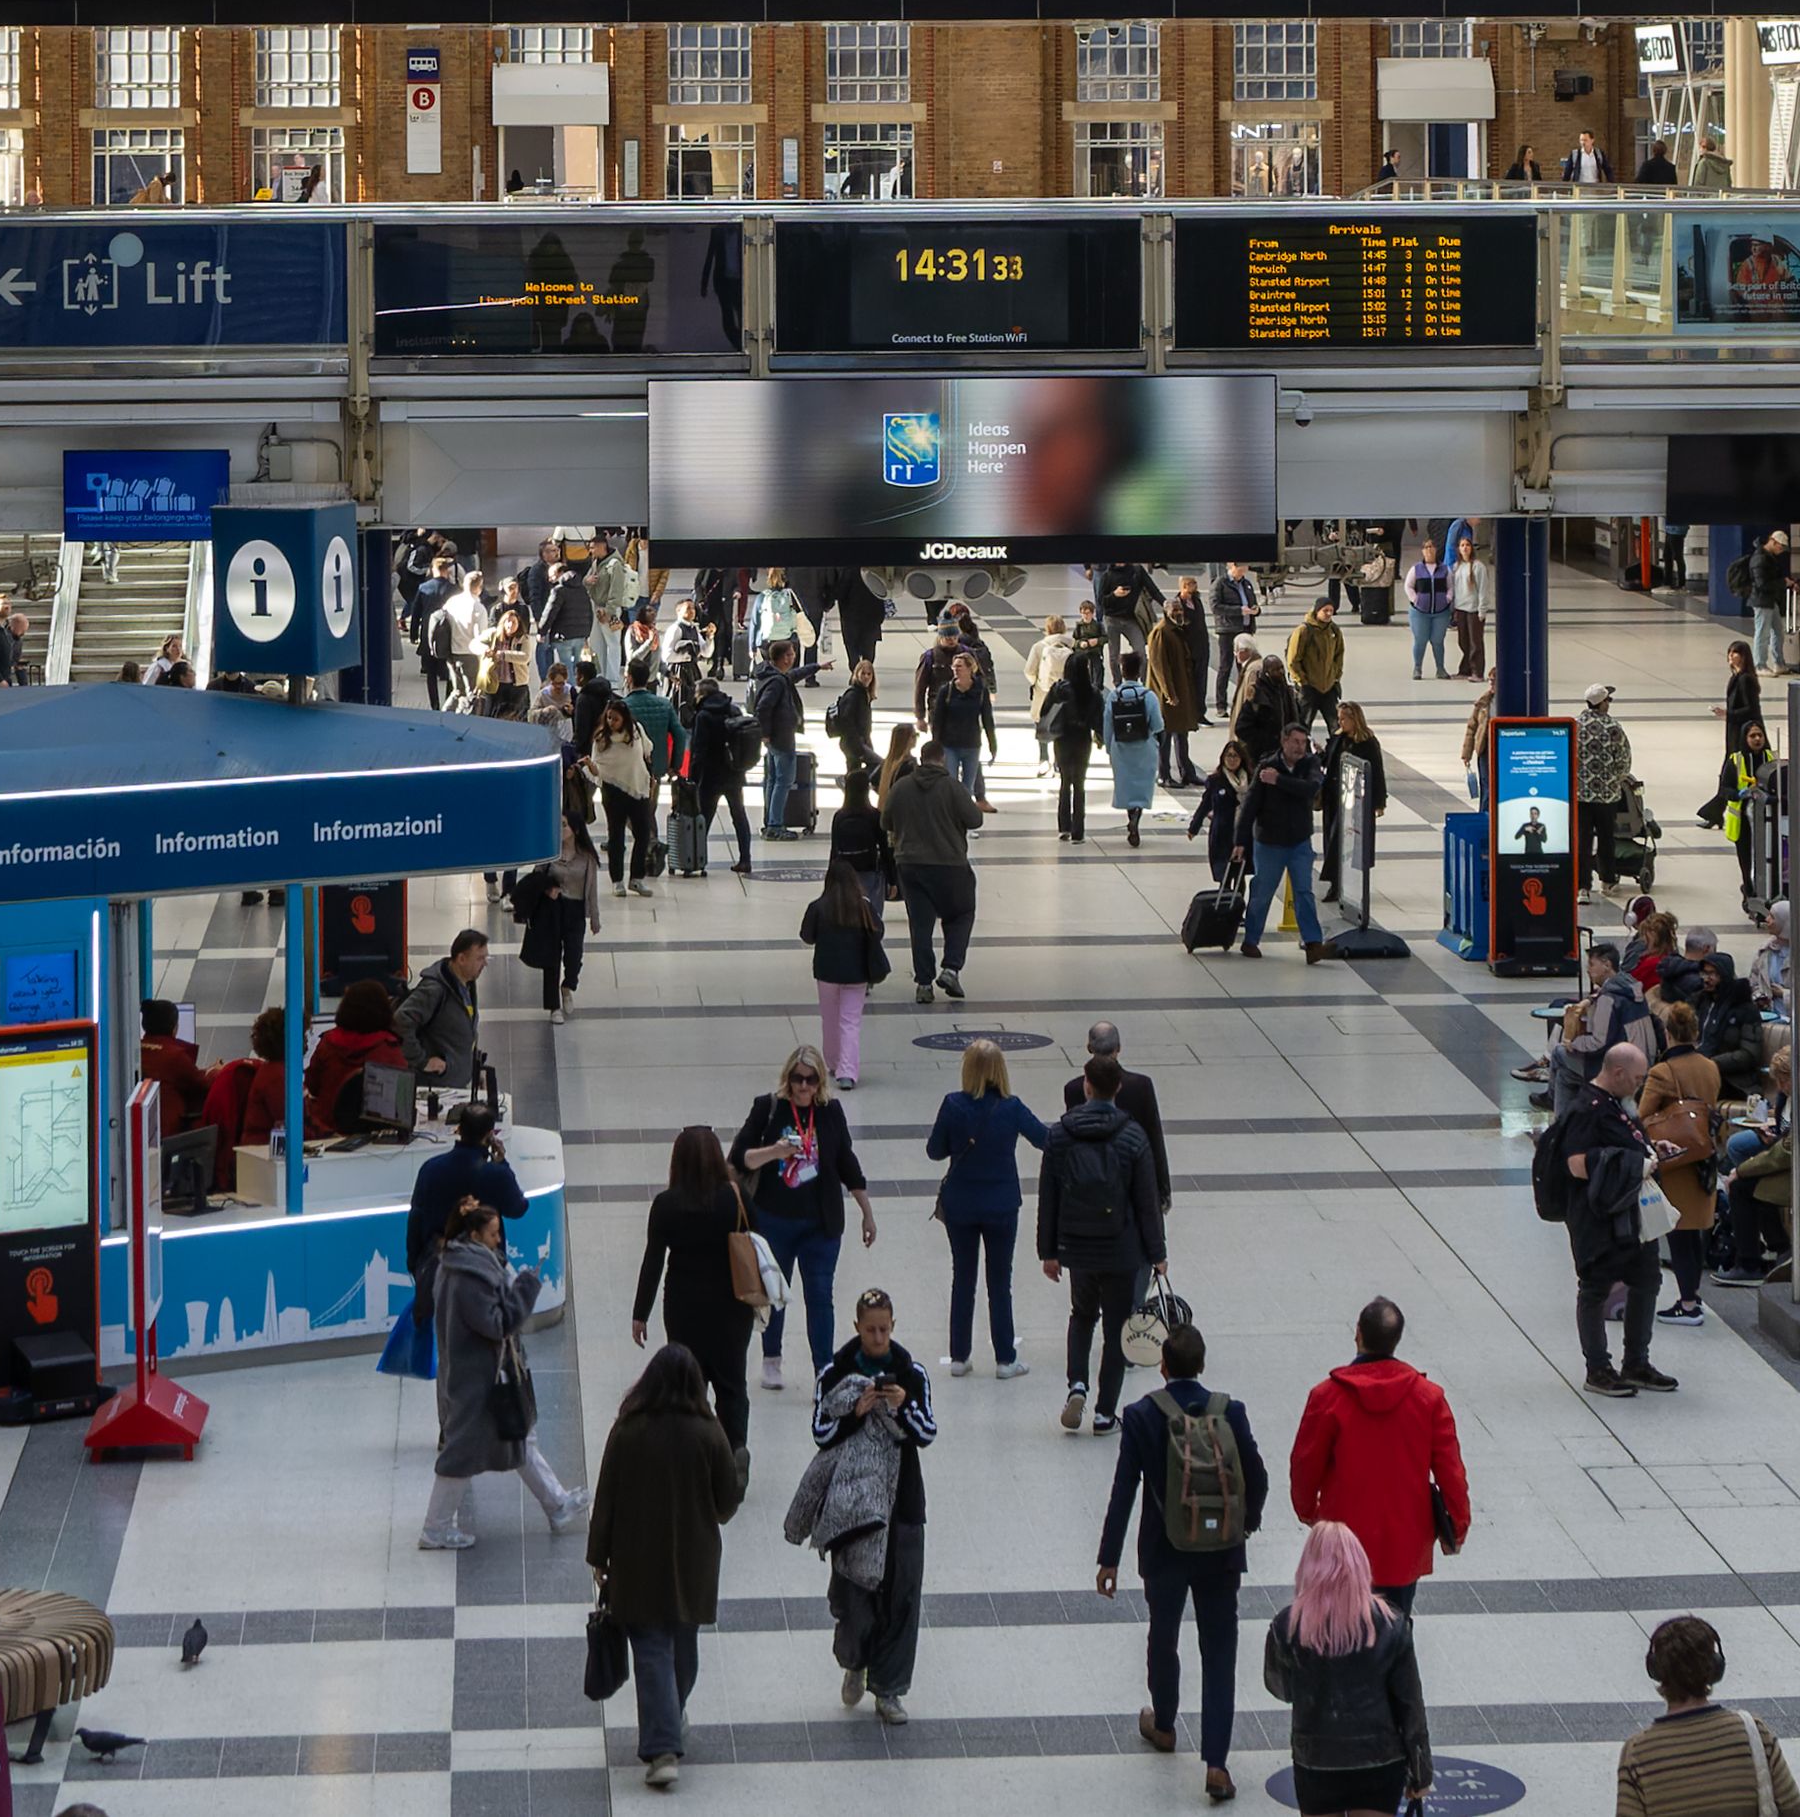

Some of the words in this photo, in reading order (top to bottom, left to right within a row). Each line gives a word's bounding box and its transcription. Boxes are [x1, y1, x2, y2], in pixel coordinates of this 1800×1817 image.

[1329, 225, 1382, 235] Arrivals
[1250, 239, 1279, 248] From
[1361, 238, 1387, 247] Time
[1392, 237, 1419, 247] Plat
[1438, 237, 1461, 246] Due
[1249, 251, 1297, 262] Cambridge
[1300, 251, 1327, 261] North
[1362, 251, 1387, 259] 14:45
[1406, 251, 1411, 259] 3
[1425, 250, 1437, 259] On
[1441, 250, 1461, 259] time
[895, 248, 986, 281] 14:31
[147, 261, 232, 306] Lift
[525, 282, 575, 292] Welcome
[579, 282, 594, 292] to
[479, 295, 539, 306] Liverpool
[545, 295, 586, 305] Street
[592, 295, 639, 304] Station
[892, 334, 931, 343] Connect
[934, 334, 944, 343] to
[946, 334, 967, 343] Free
[969, 333, 1004, 343] Station
[1005, 333, 1027, 343] WiFi
[967, 422, 1010, 437] Ideas
[967, 441, 1026, 458] Happen
[967, 459, 1004, 474] Here
[919, 543, 1008, 560] JCDecaux
[313, 815, 444, 843] Informazioni
[155, 827, 280, 855] Information
